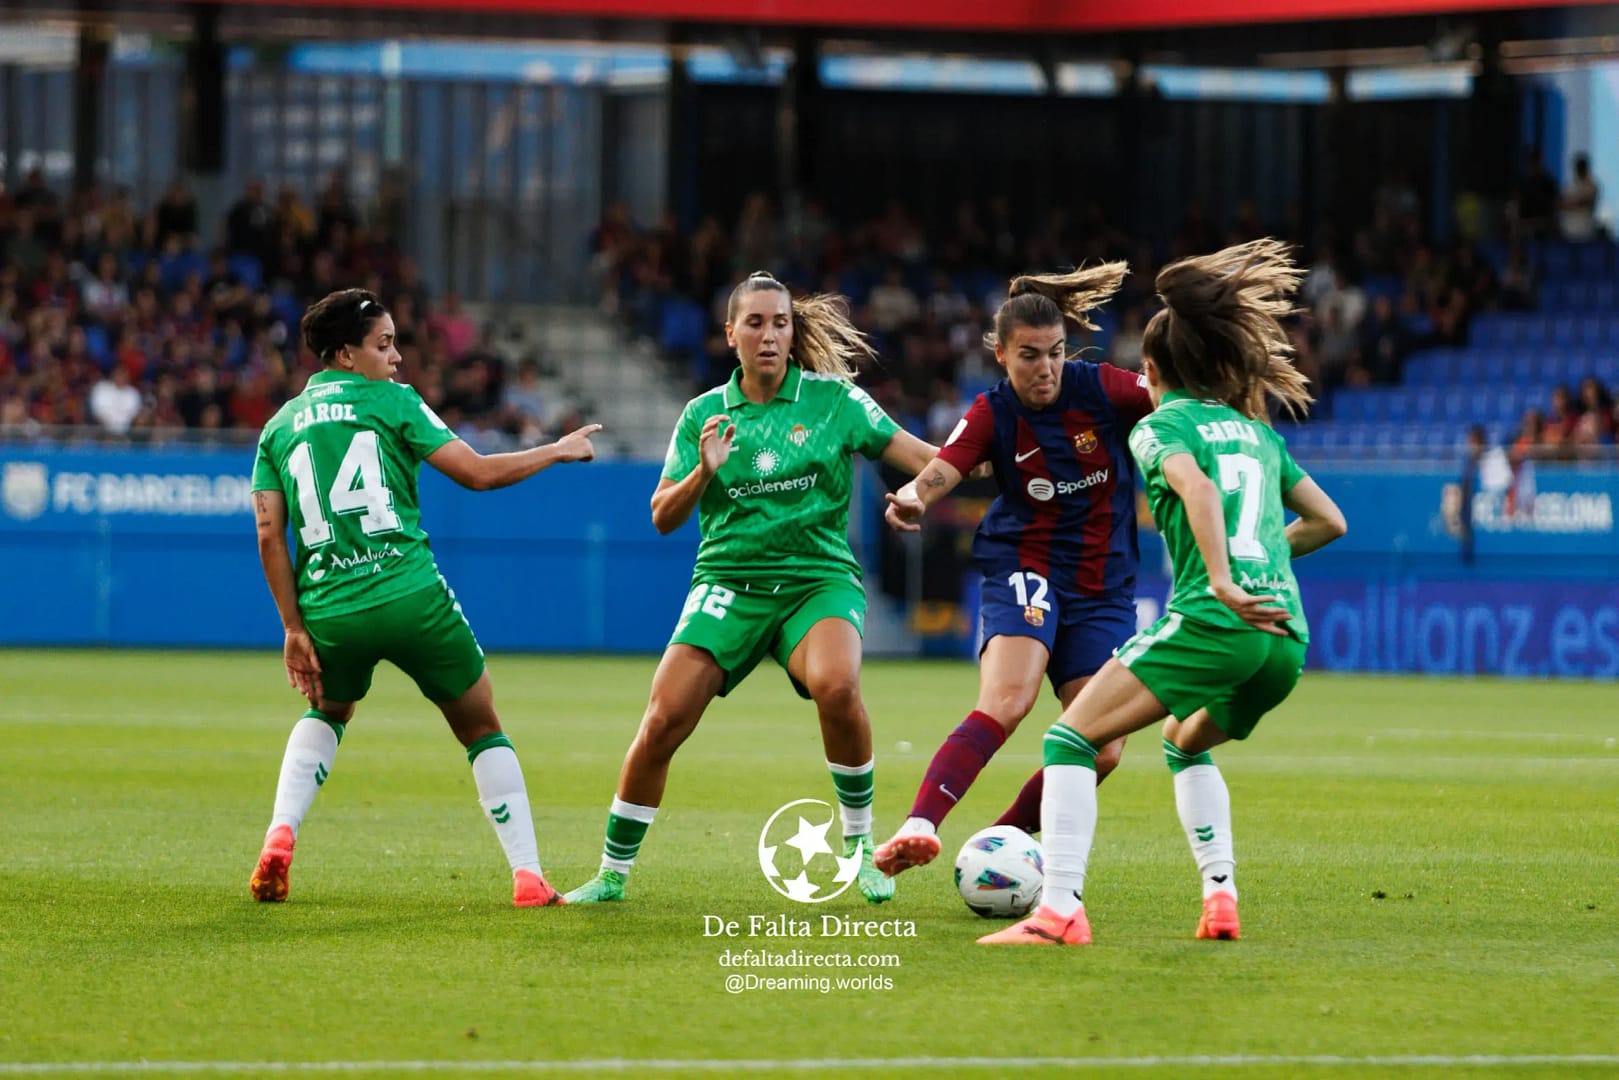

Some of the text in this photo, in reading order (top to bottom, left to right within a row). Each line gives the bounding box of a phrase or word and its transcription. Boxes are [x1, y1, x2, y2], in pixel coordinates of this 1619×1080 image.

[294, 402, 357, 432] CAROL
[55, 472, 251, 514] FC BARCELON
[288, 430, 403, 549] 14
[722, 472, 818, 499] ocialenergy
[1057, 469, 1109, 494] Spotify
[1217, 453, 1269, 563] 7
[331, 542, 404, 569] Andalucía
[1008, 571, 1051, 612] 12
